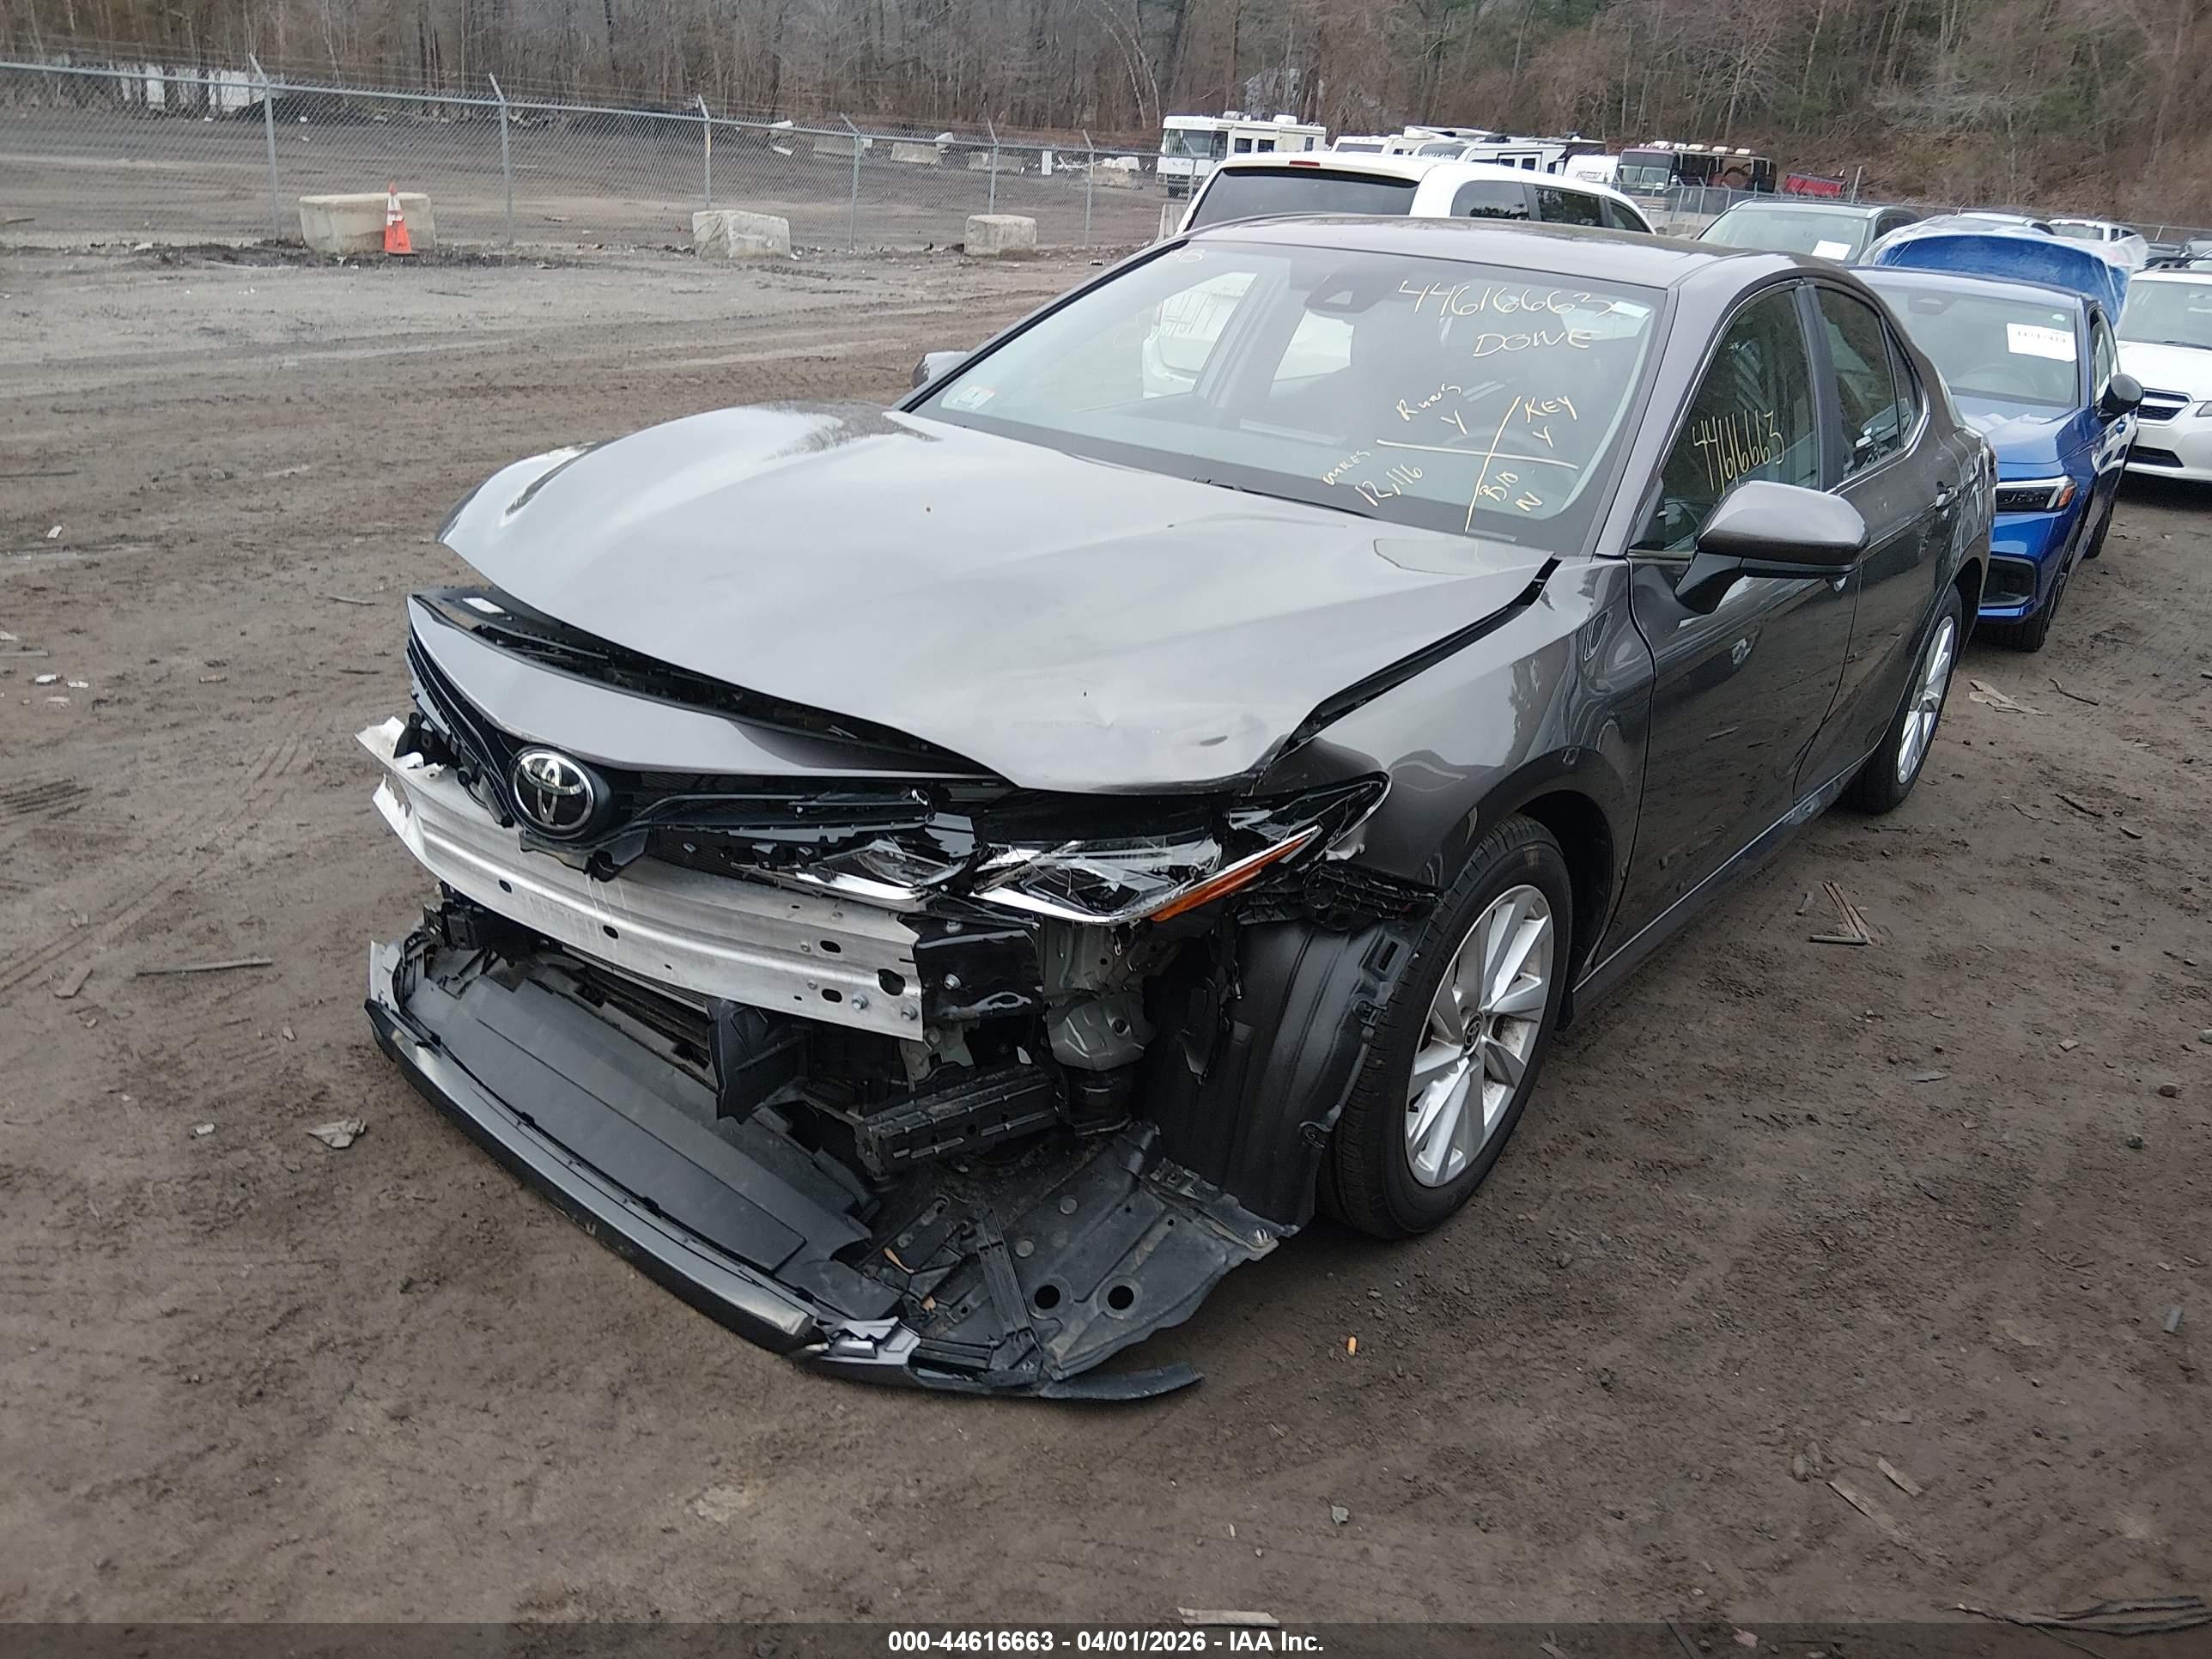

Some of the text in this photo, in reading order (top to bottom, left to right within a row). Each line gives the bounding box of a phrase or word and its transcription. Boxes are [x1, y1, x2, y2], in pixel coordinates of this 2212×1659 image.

[1398, 279, 1616, 318] 44616663
[1473, 329, 1602, 357] DONE
[1440, 410, 1468, 435] Y
[1524, 395, 1577, 423] KEY
[1531, 425, 1553, 448] Y
[1692, 409, 1785, 495] 44616663
[1354, 464, 1423, 507] 12,116
[1515, 491, 1543, 512] N
